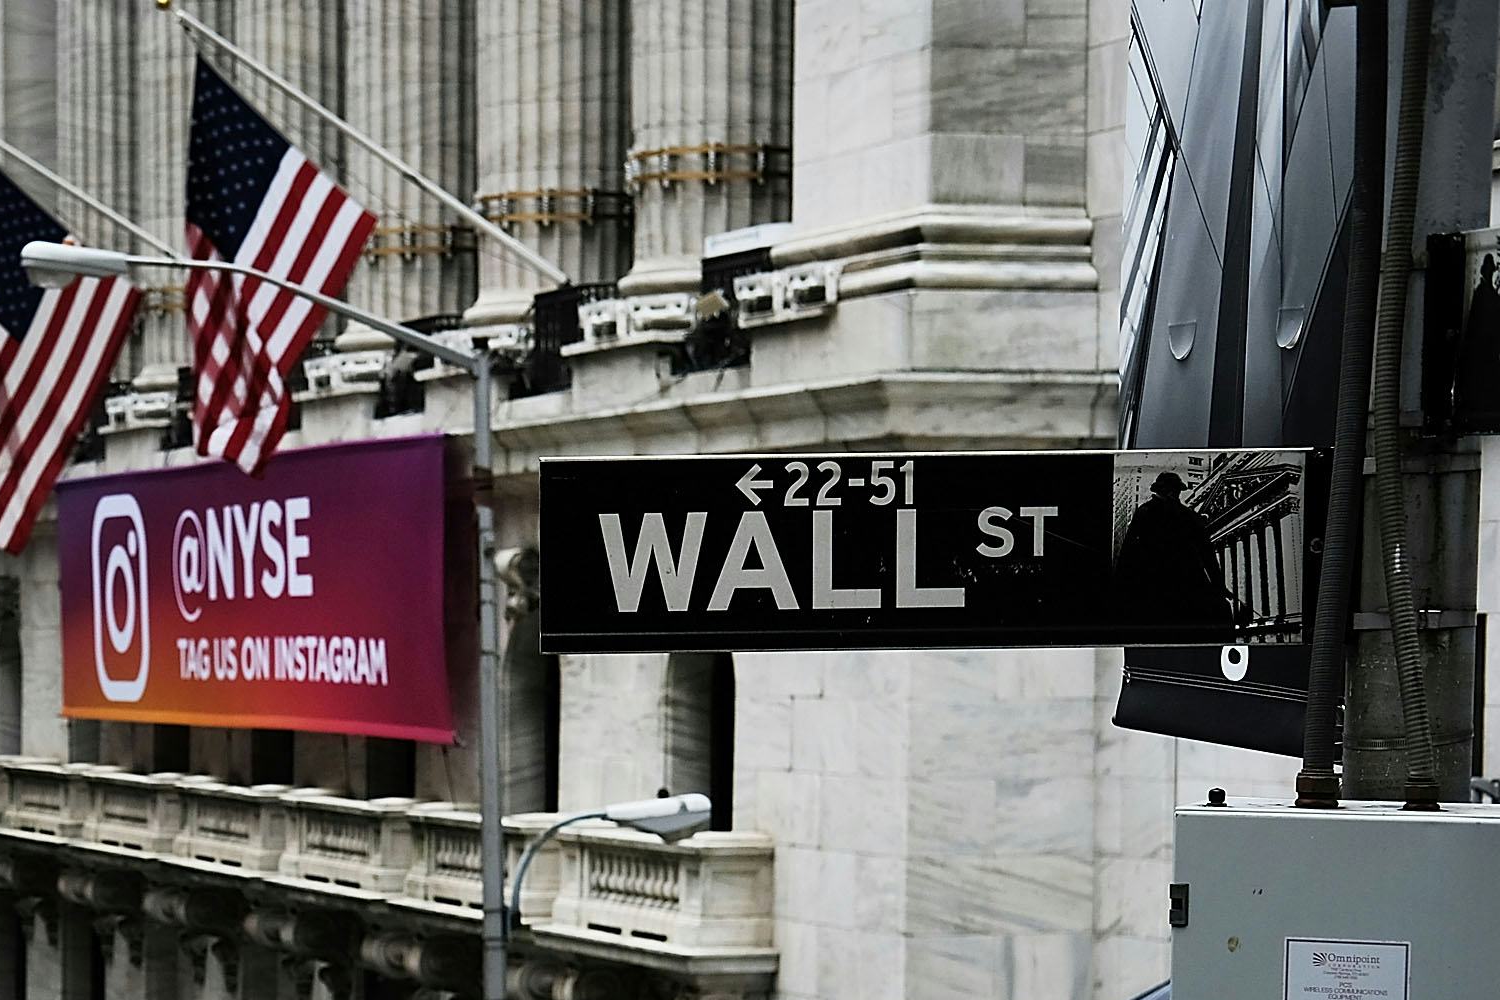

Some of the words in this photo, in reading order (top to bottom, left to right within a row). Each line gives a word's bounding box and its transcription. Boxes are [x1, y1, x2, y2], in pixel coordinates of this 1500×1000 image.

[784, 460, 915, 506] 22-51
[172, 496, 314, 622] @NYSE
[598, 508, 966, 612] WALL
[975, 506, 1059, 558] ST
[176, 636, 212, 682] TAG
[213, 636, 238, 682] US
[240, 635, 270, 681] ON
[273, 635, 389, 687] INSTAGRAM
[1328, 953, 1380, 965] Omnipoint
[1334, 987, 1388, 997] COMMUNICATIONS
